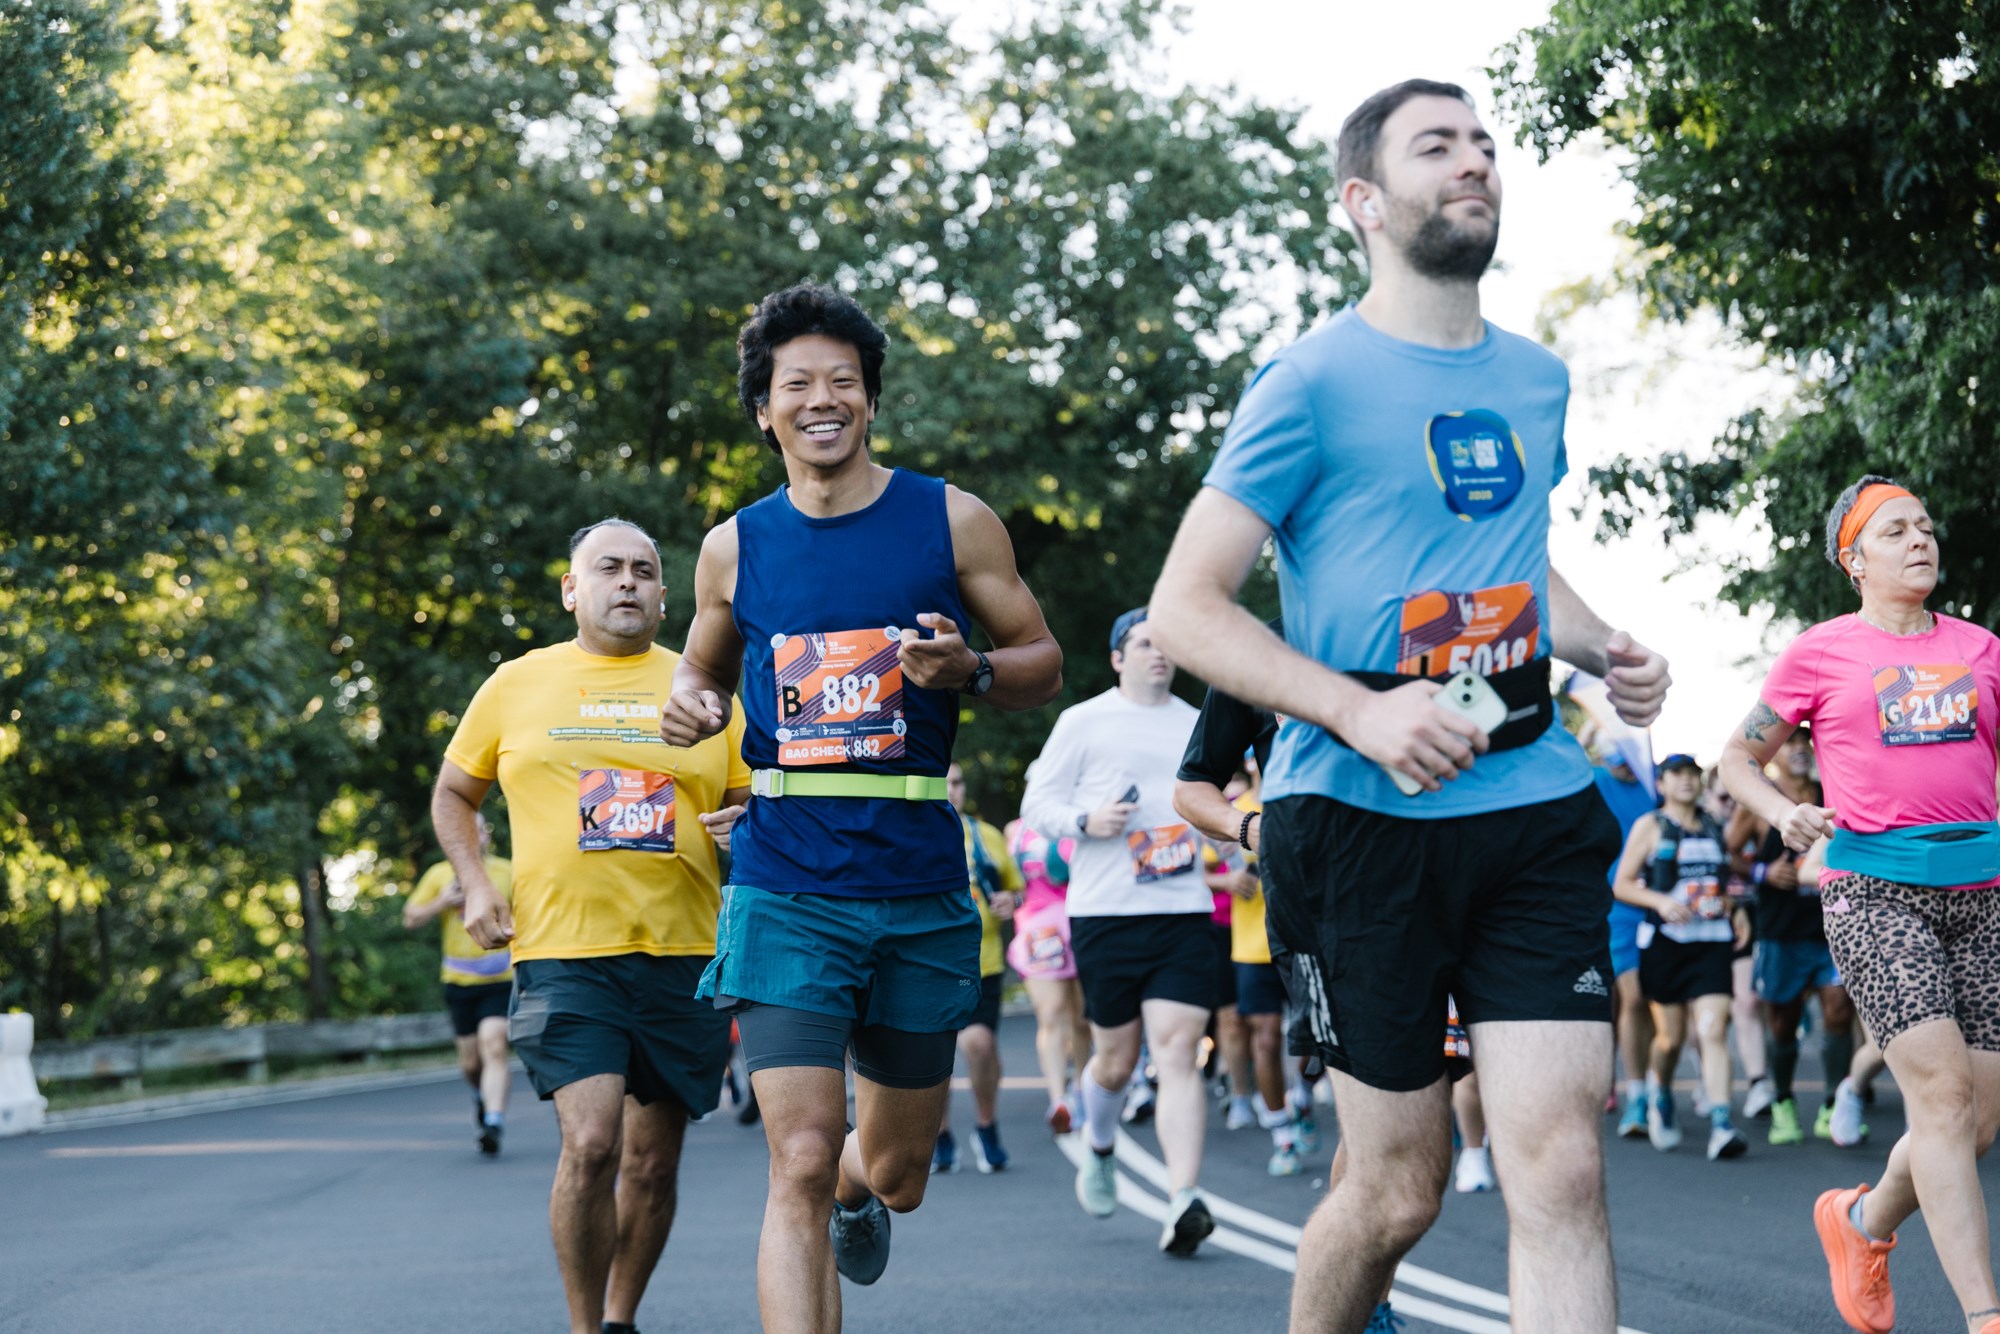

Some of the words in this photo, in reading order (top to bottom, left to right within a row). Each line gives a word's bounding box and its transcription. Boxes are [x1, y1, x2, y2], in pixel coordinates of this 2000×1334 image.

[579, 704, 659, 719] HARLEM
[783, 686, 803, 718] B
[822, 673, 881, 715] 882
[1885, 699, 1905, 727] G
[1909, 693, 1970, 726] 2143
[785, 747, 809, 759] BAG
[811, 744, 851, 757] CHECK
[853, 739, 880, 758] 882
[581, 805, 599, 830] K
[608, 801, 667, 835] 2697
